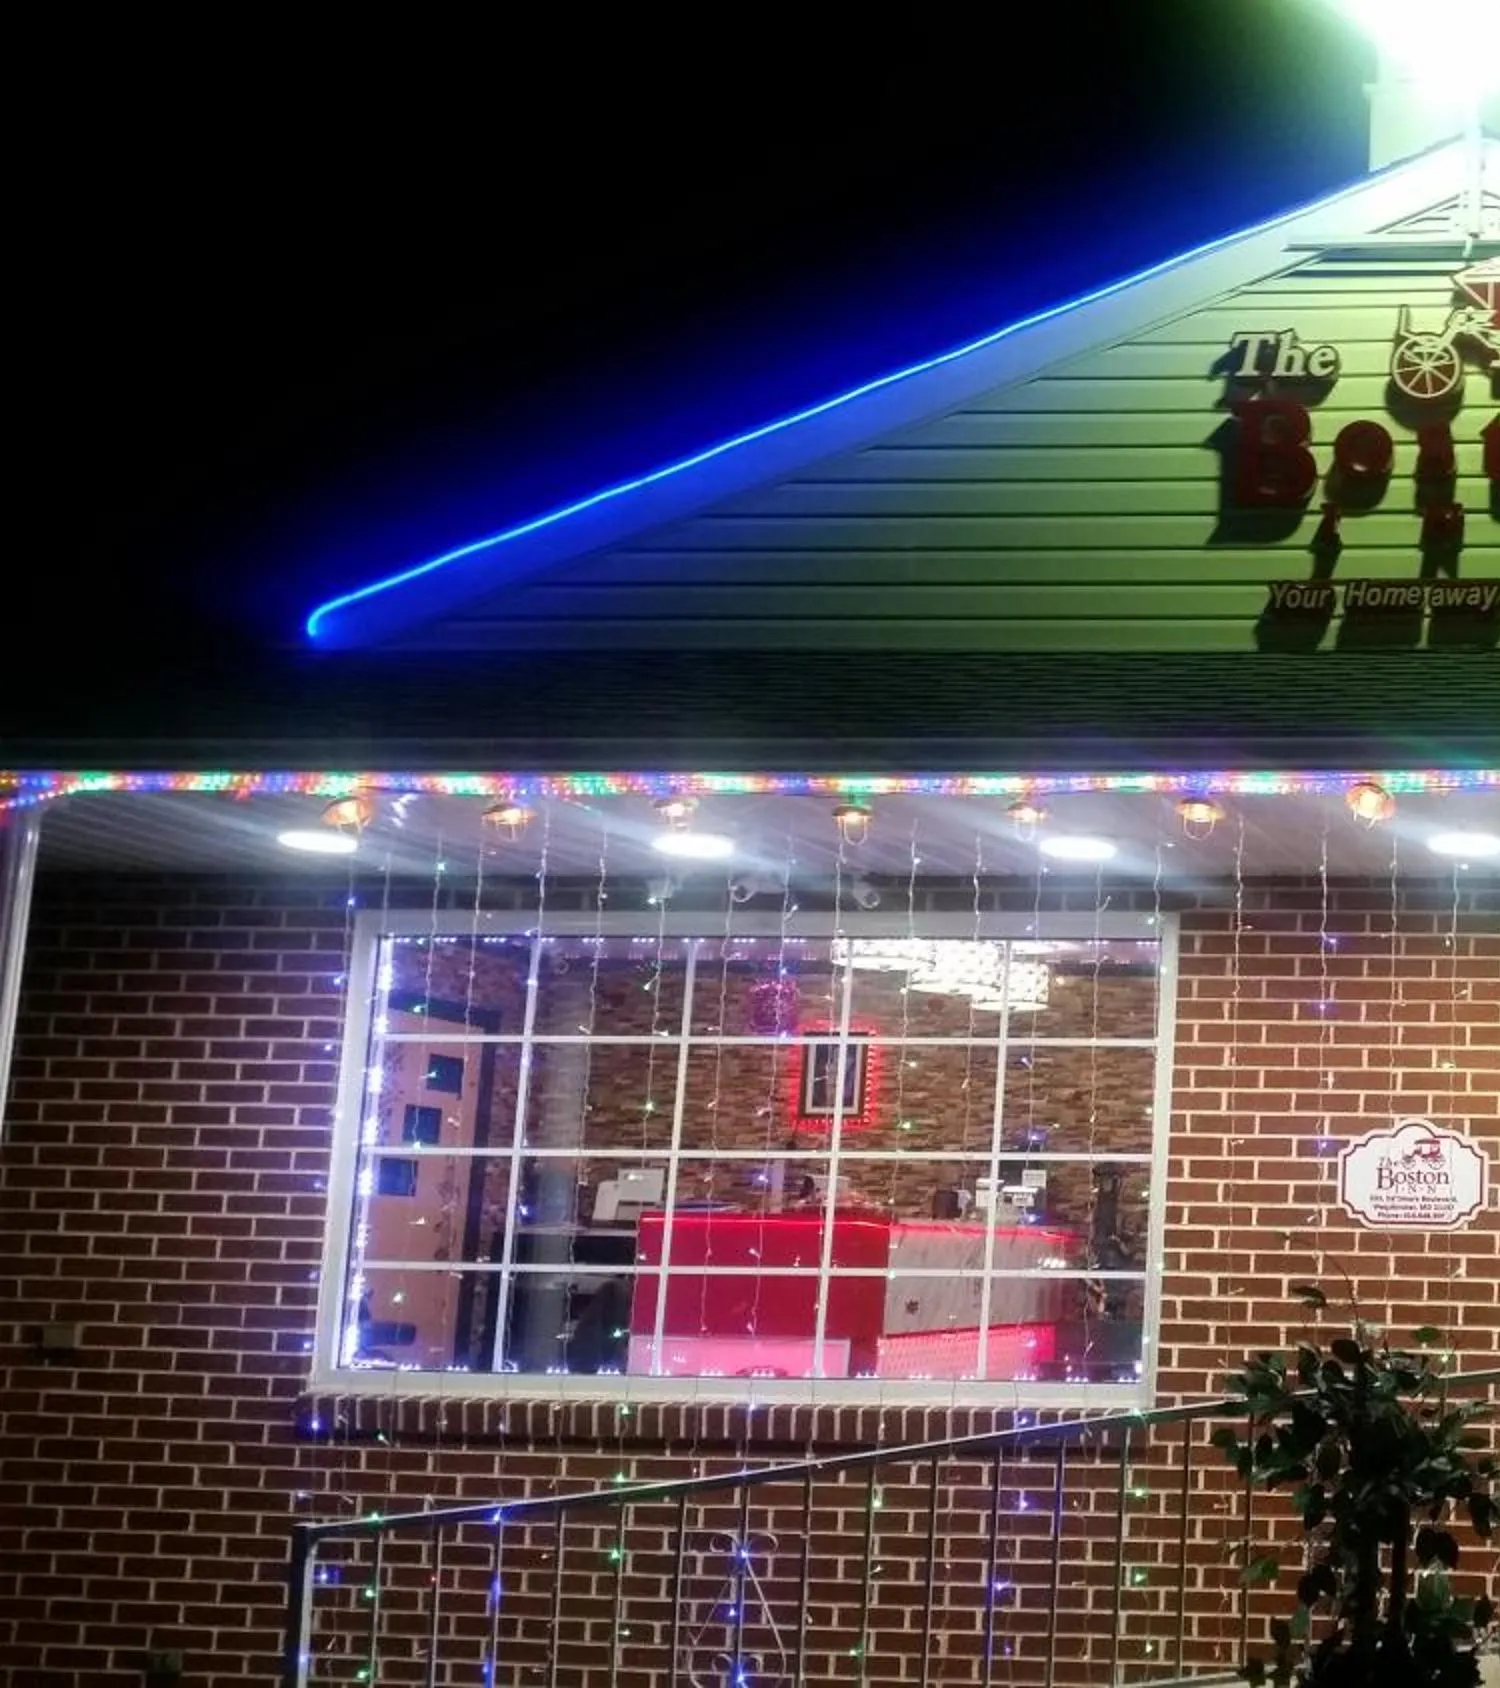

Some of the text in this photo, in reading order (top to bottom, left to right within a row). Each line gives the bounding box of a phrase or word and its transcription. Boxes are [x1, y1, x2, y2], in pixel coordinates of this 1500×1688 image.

[1232, 328, 1338, 377] The
[1271, 582, 1333, 610] Your
[1346, 580, 1422, 608] Home
[1431, 582, 1499, 613] away
[1376, 1167, 1449, 1190] Boston
